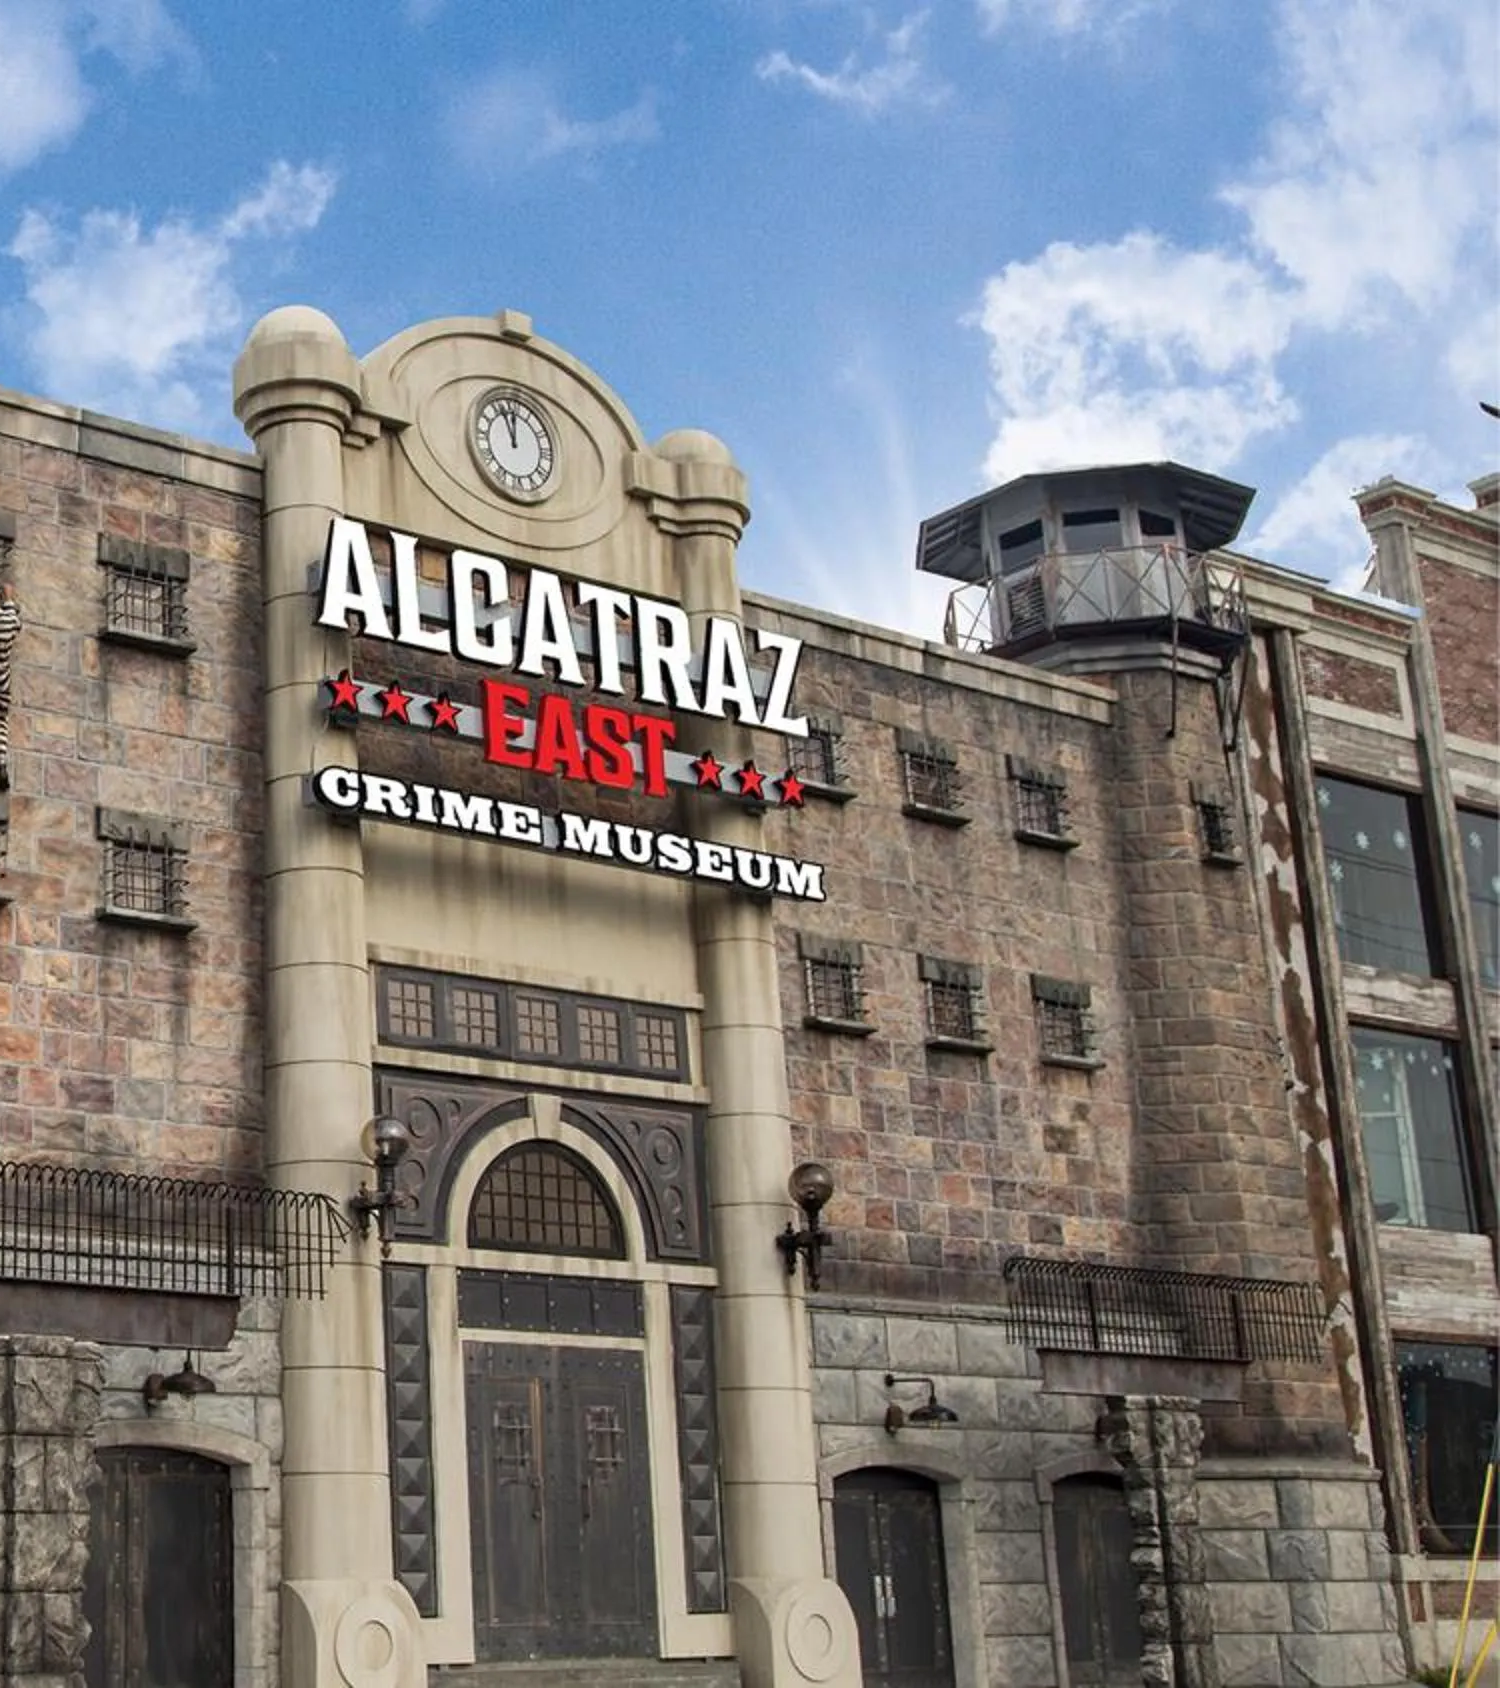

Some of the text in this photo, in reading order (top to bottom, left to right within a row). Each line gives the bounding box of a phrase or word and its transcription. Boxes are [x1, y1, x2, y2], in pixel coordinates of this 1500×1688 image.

[318, 518, 809, 737] ALCATRAZ
[480, 679, 676, 797] EAST
[319, 767, 825, 899] CRIME MUSEUM
